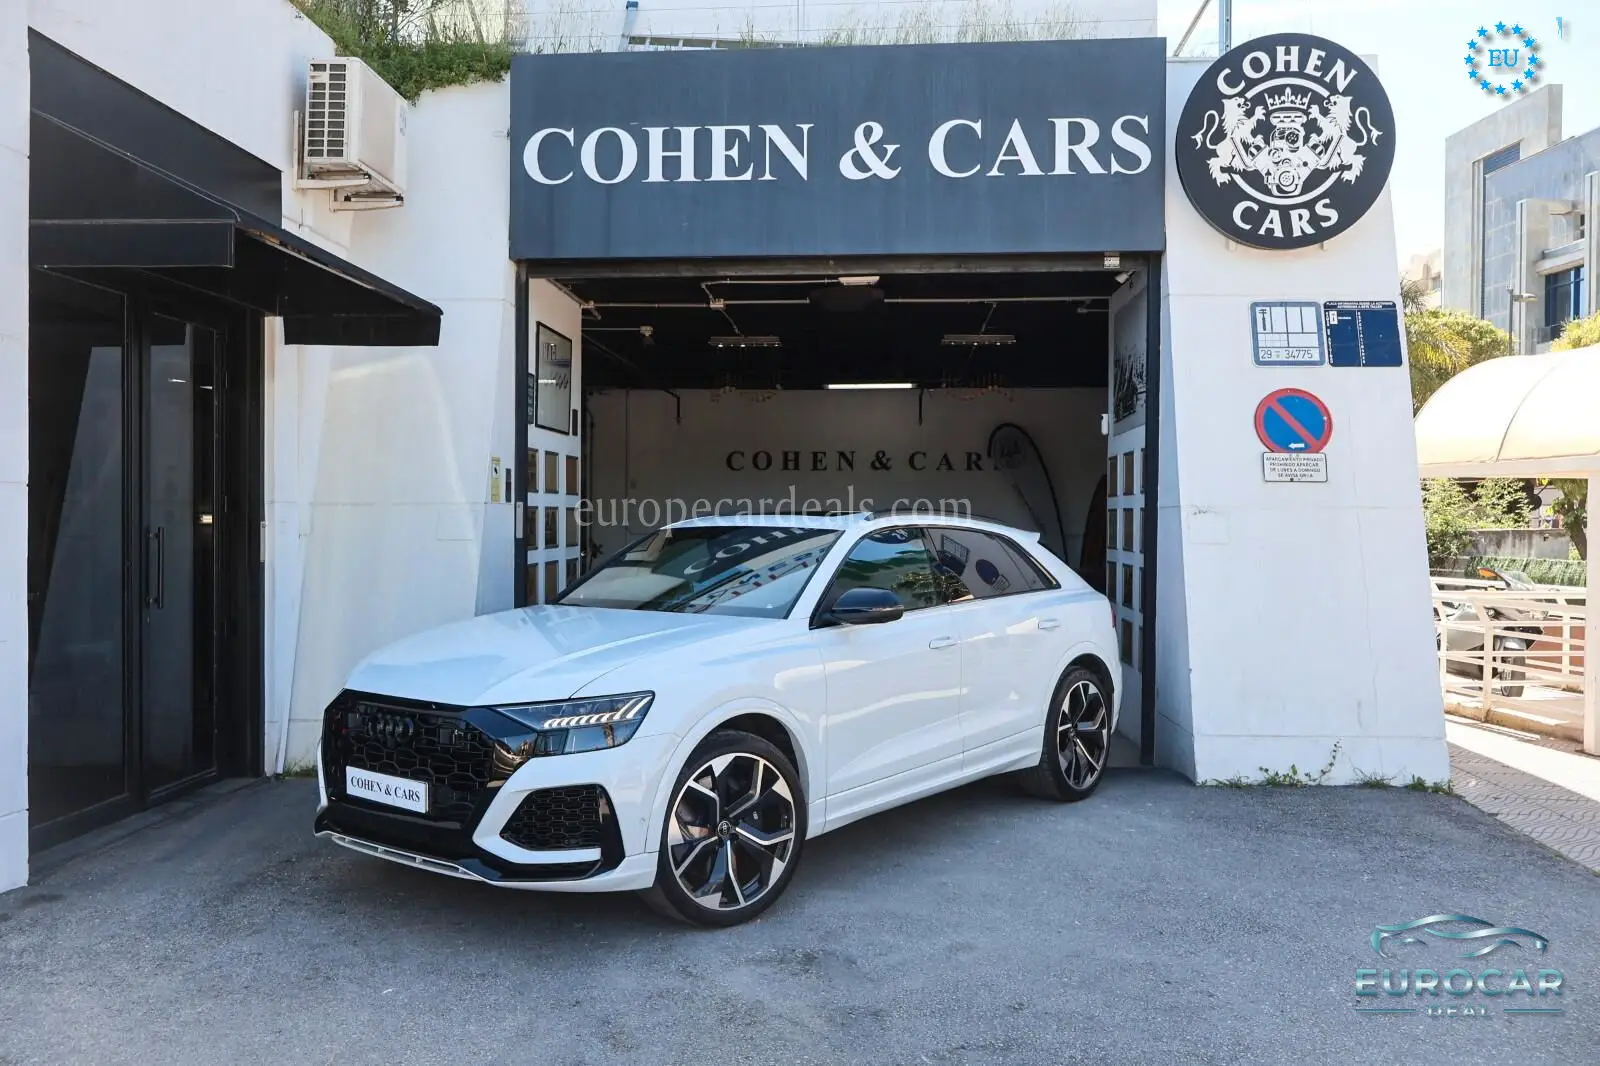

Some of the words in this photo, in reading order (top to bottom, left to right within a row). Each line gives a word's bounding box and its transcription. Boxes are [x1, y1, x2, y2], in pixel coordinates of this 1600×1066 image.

[1216, 45, 1358, 95] COHEN
[522, 123, 815, 185] COHEN
[838, 120, 902, 181] &
[928, 114, 1153, 178] CARS
[1232, 198, 1339, 238] CARS
[1260, 349, 1273, 359] 29
[1284, 349, 1313, 359] 34775
[726, 450, 856, 471] COHEN
[870, 449, 893, 471] &
[908, 450, 1004, 471] CAR
[350, 775, 382, 793] COHEN
[384, 783, 392, 796] &
[394, 786, 421, 803] CARS
